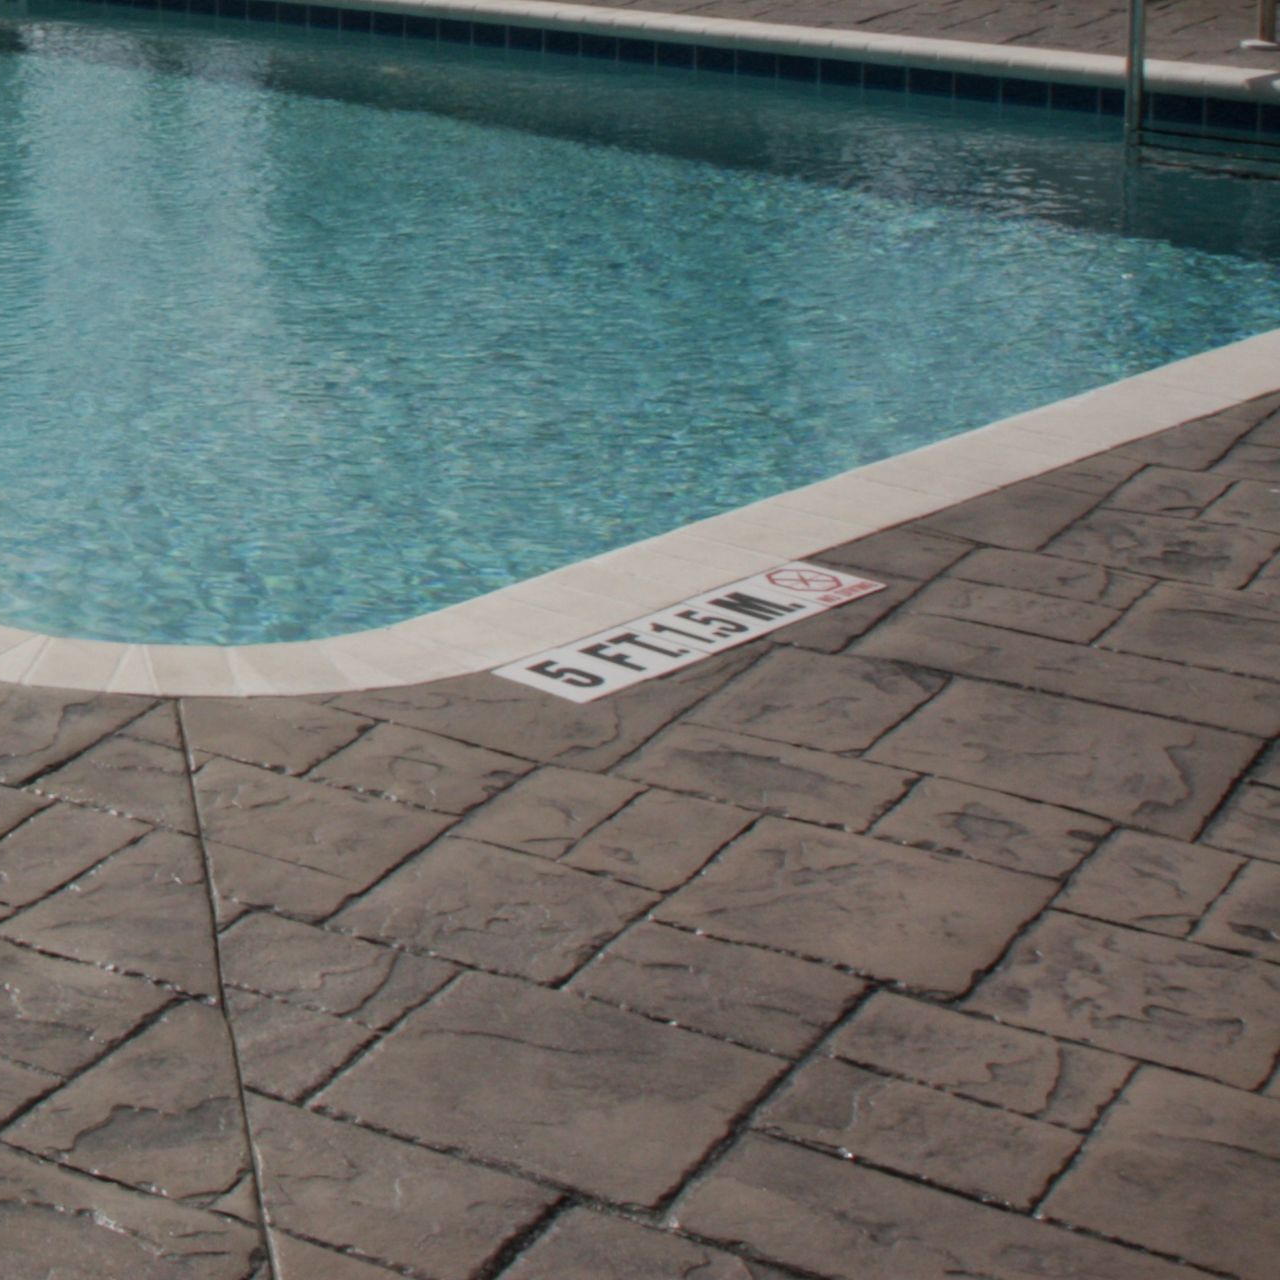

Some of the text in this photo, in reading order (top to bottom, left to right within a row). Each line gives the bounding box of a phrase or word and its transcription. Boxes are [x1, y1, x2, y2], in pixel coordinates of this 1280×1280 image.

[526, 659, 604, 688] 5
[577, 632, 691, 672] FT.
[649, 609, 749, 645] 1.5
[707, 592, 806, 621] M.
